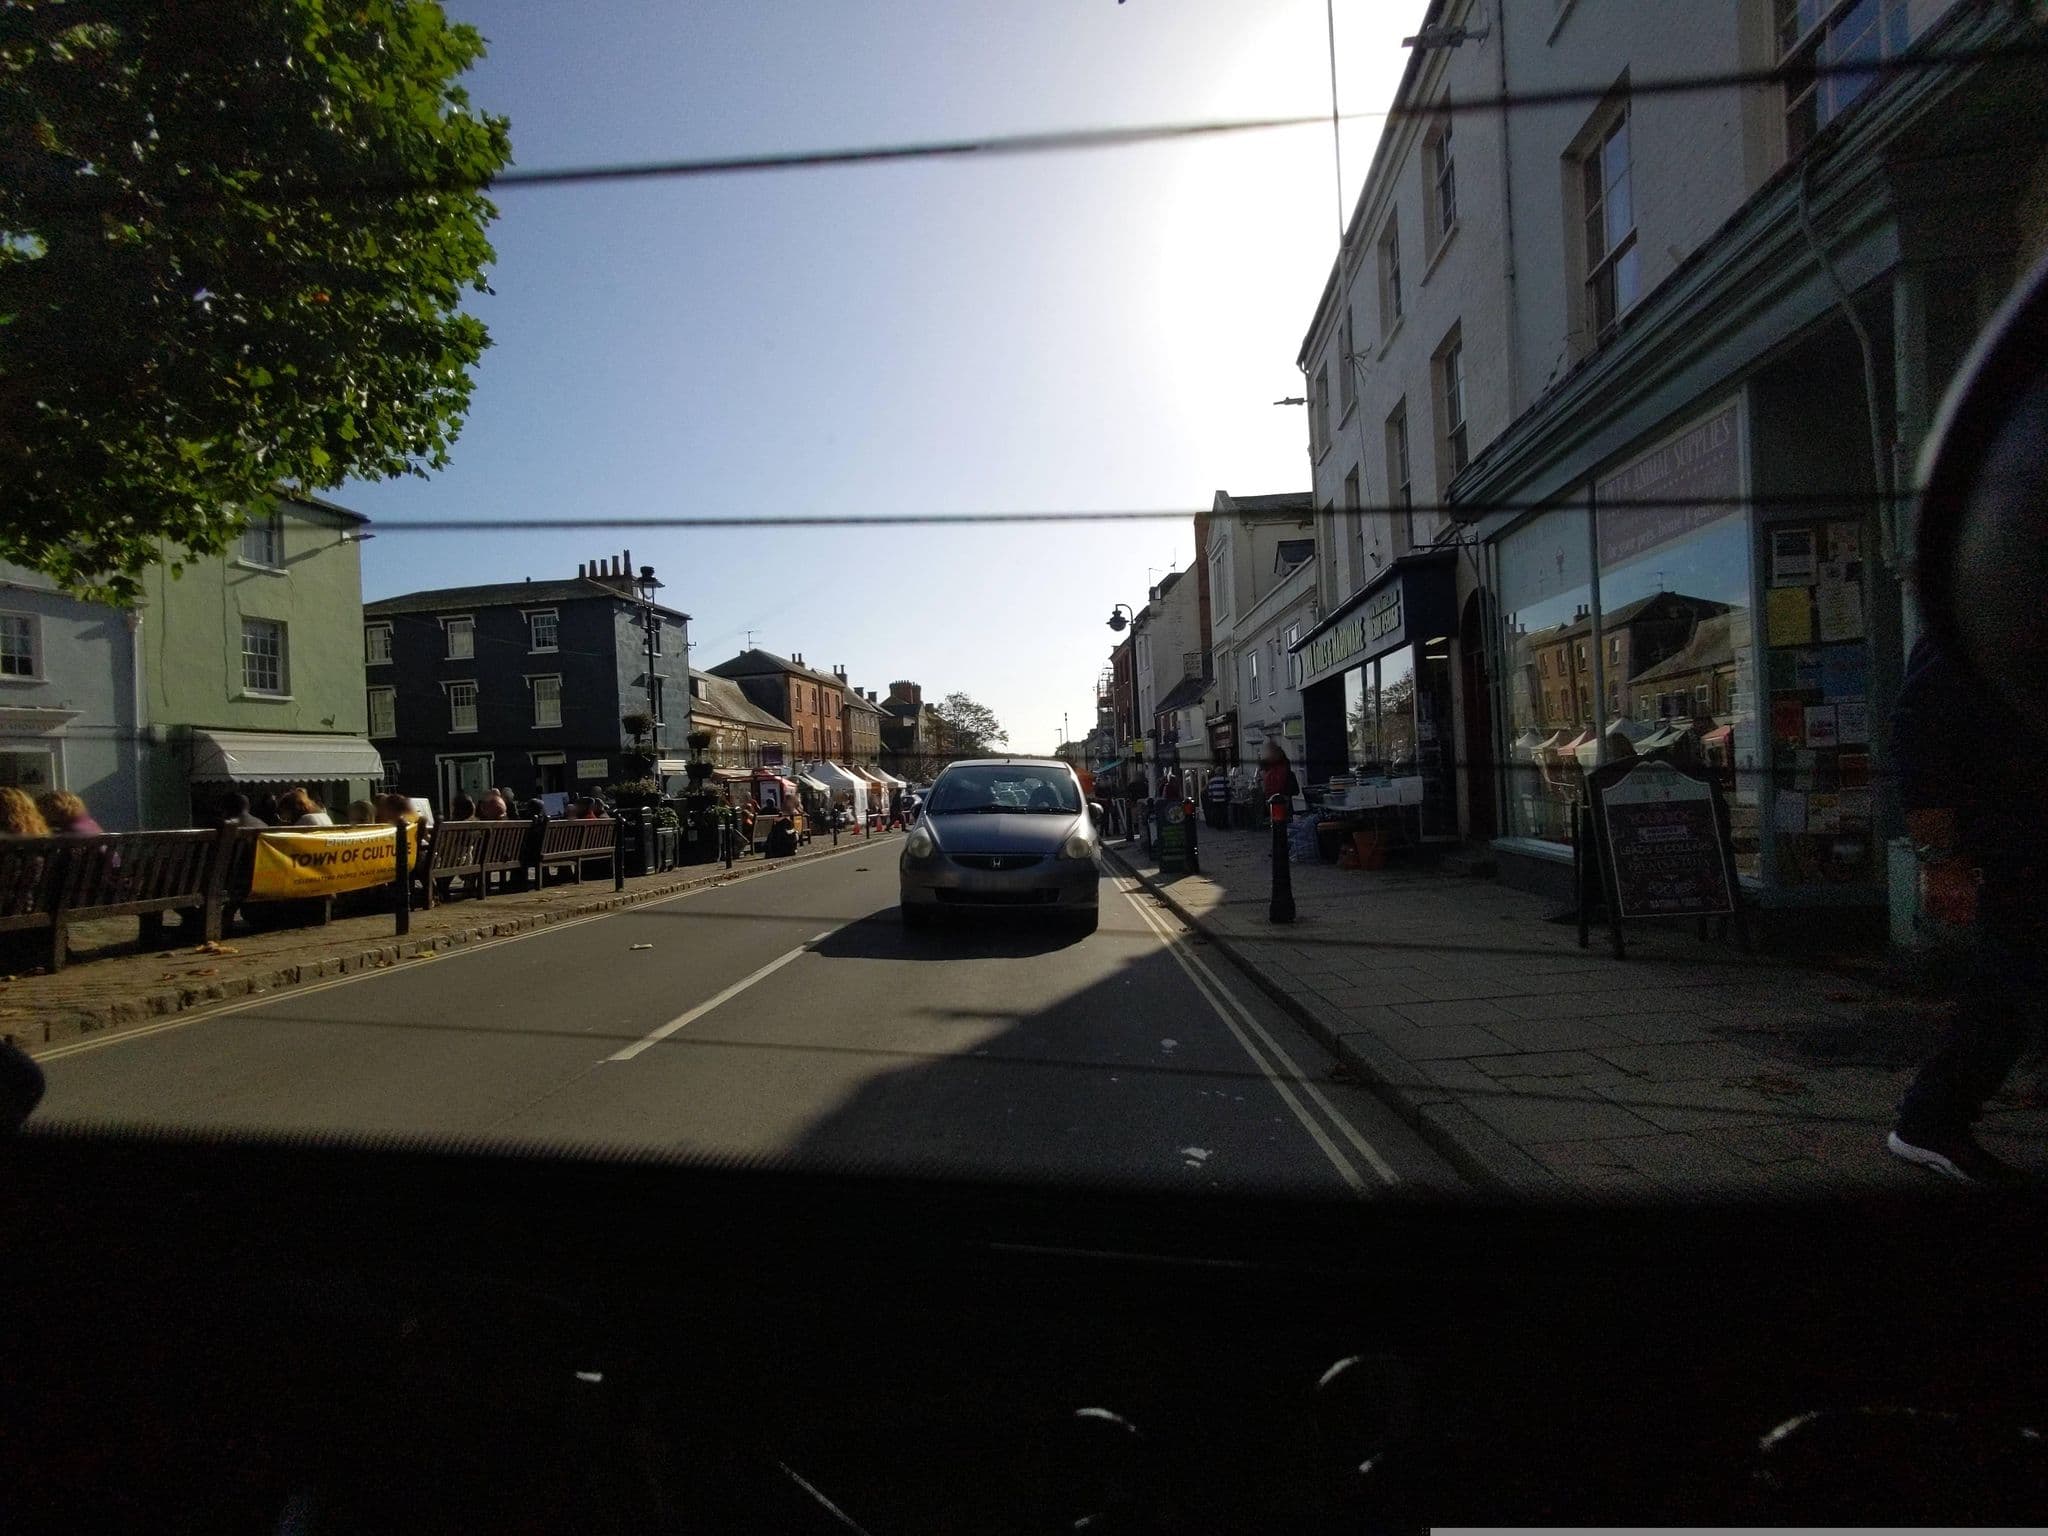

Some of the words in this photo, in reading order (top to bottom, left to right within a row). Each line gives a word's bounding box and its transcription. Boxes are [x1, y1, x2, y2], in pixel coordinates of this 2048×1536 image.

[290, 850, 338, 869] TOWN
[341, 848, 359, 863] OF
[362, 842, 411, 861] CULTUE
